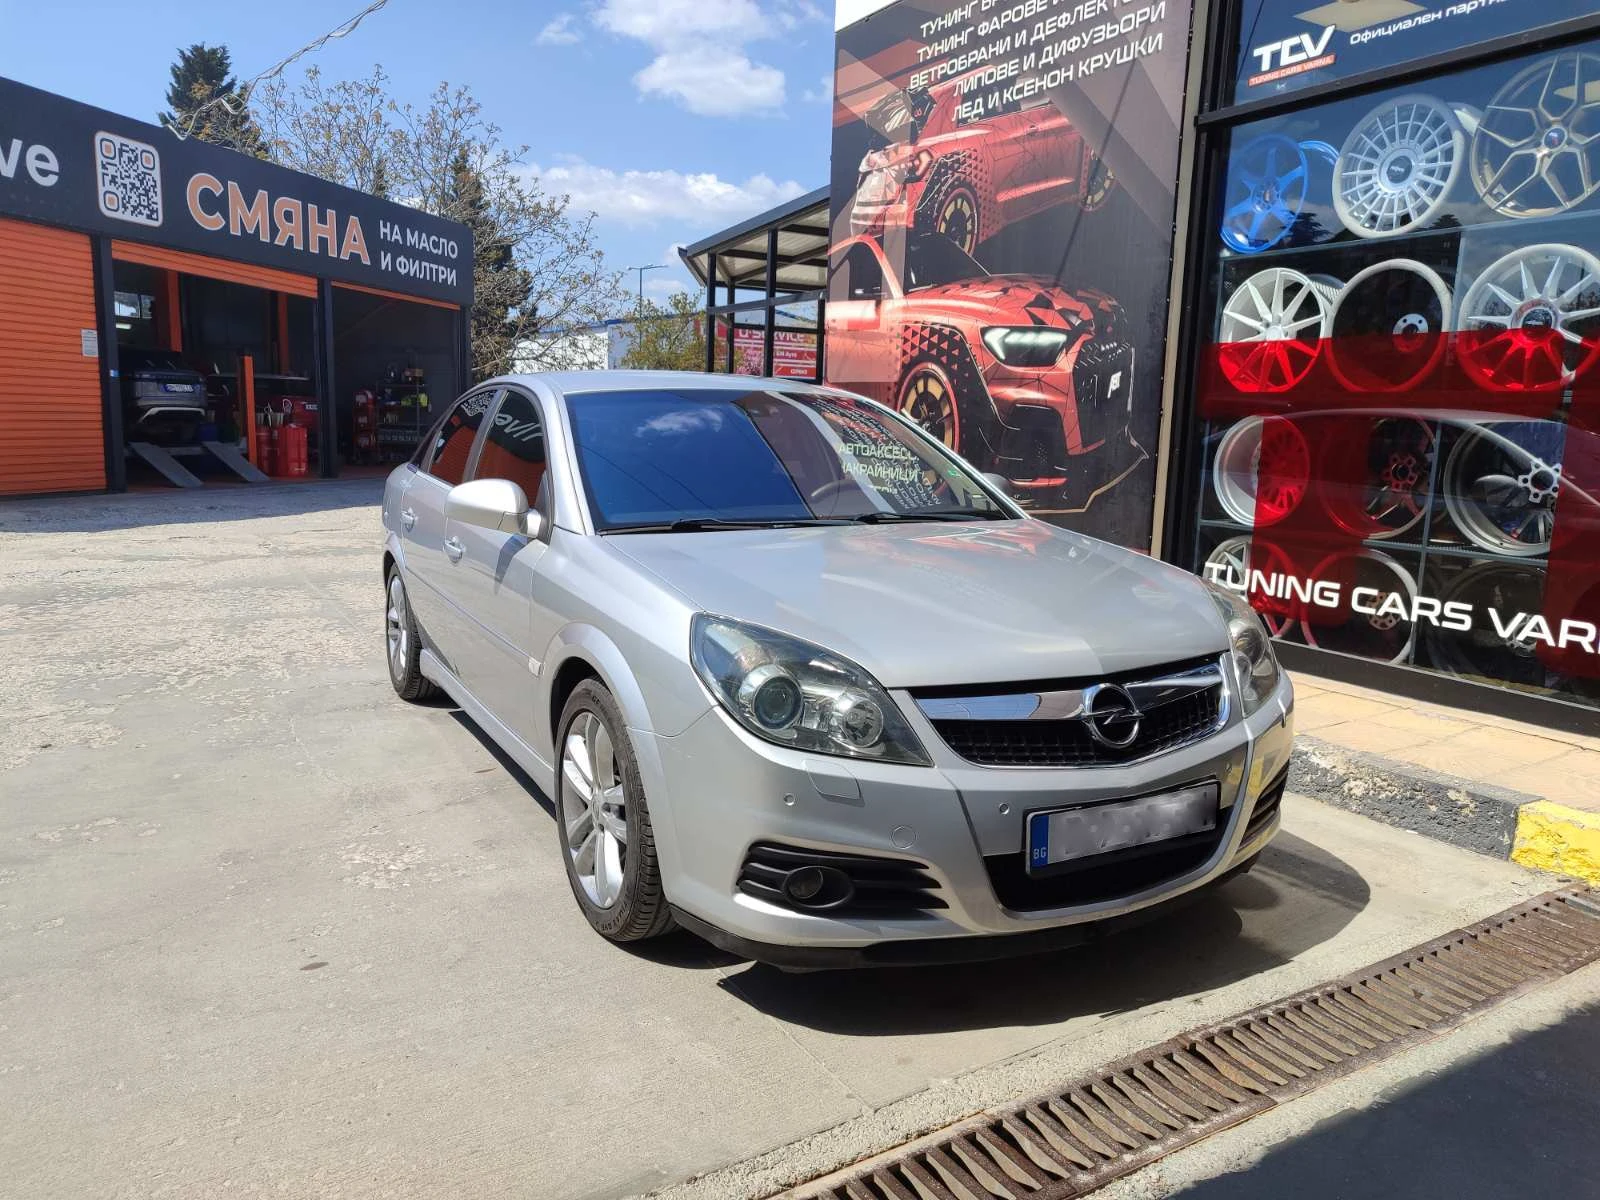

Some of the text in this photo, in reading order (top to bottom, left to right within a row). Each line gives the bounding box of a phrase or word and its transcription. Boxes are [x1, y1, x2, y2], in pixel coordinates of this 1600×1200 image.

[909, 0, 1133, 89] ВЕТРОБРАНИ И ДЕФЛЕК
[916, 0, 1048, 63] ТУНИНГ ФАРОВЕ
[919, 0, 979, 38] ТУНИНГ
[1350, 10, 1442, 44] Официален
[953, 1, 1166, 97] ЛИПОВЕ И ДИФУЗЬОРИ
[1253, 24, 1336, 72] TCV
[951, 32, 1164, 122] ЛЕД И КСЕНОН КРУШКИ
[186, 172, 371, 266] СМЯНА
[379, 219, 459, 259] НА МАСЛО
[380, 250, 457, 287] И ФИЛТРИ
[1205, 561, 1600, 655] TUNING CARS VAR
[1033, 847, 1046, 860] BG
